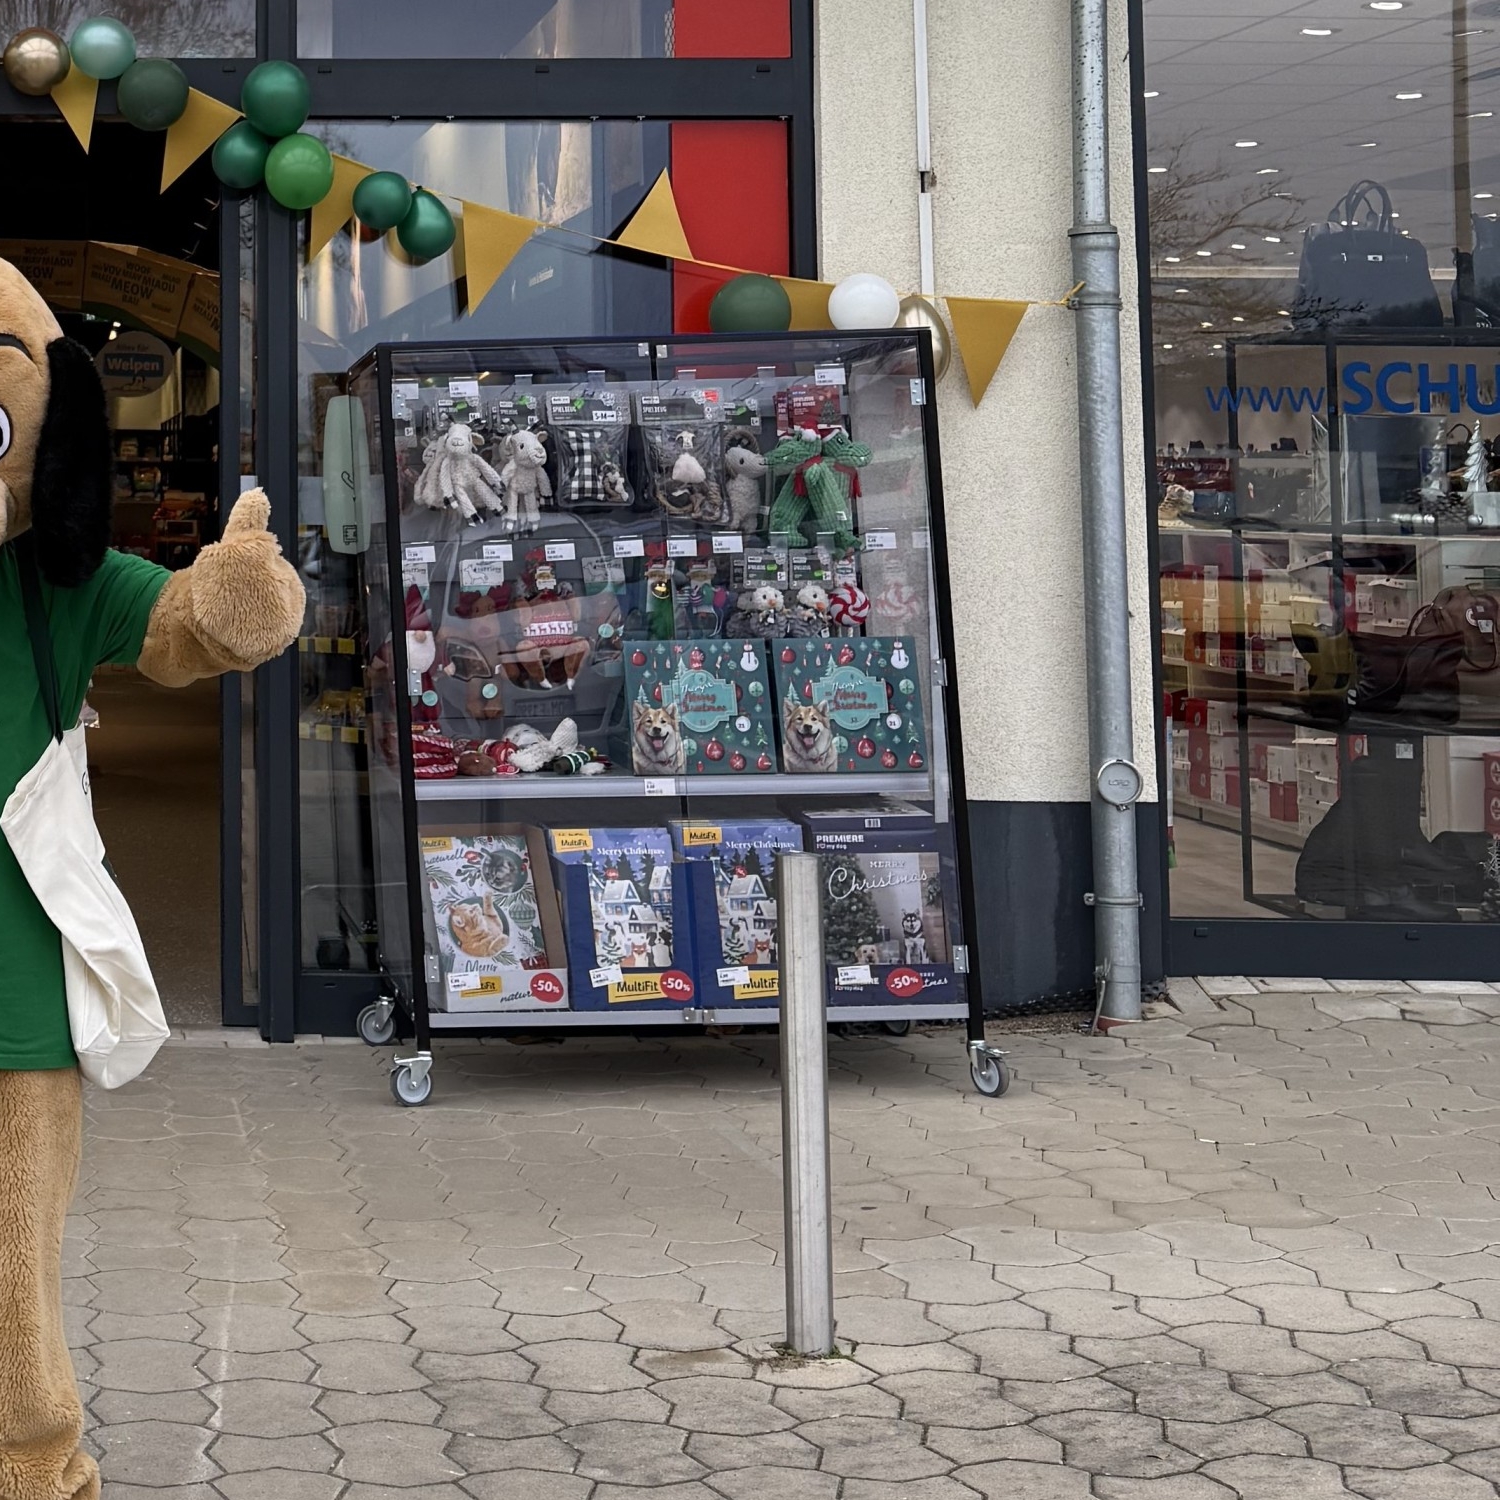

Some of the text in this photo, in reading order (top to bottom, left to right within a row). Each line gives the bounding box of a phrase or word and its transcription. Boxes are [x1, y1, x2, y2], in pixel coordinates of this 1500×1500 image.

[110, 277, 154, 299] MEOW
[107, 357, 161, 375] Welpen
[690, 831, 717, 841] MultiFit
[816, 834, 864, 843] PREMIERE
[560, 839, 588, 848] MultiFit
[726, 839, 795, 850] Merry Christmas
[597, 846, 665, 857] Merry Christmas
[869, 860, 906, 868] MERRY
[828, 867, 928, 900] Christmas
[533, 980, 560, 993] -50%
[616, 979, 659, 993] MultiFit
[663, 980, 691, 992] -50%
[891, 975, 919, 989] -50%
